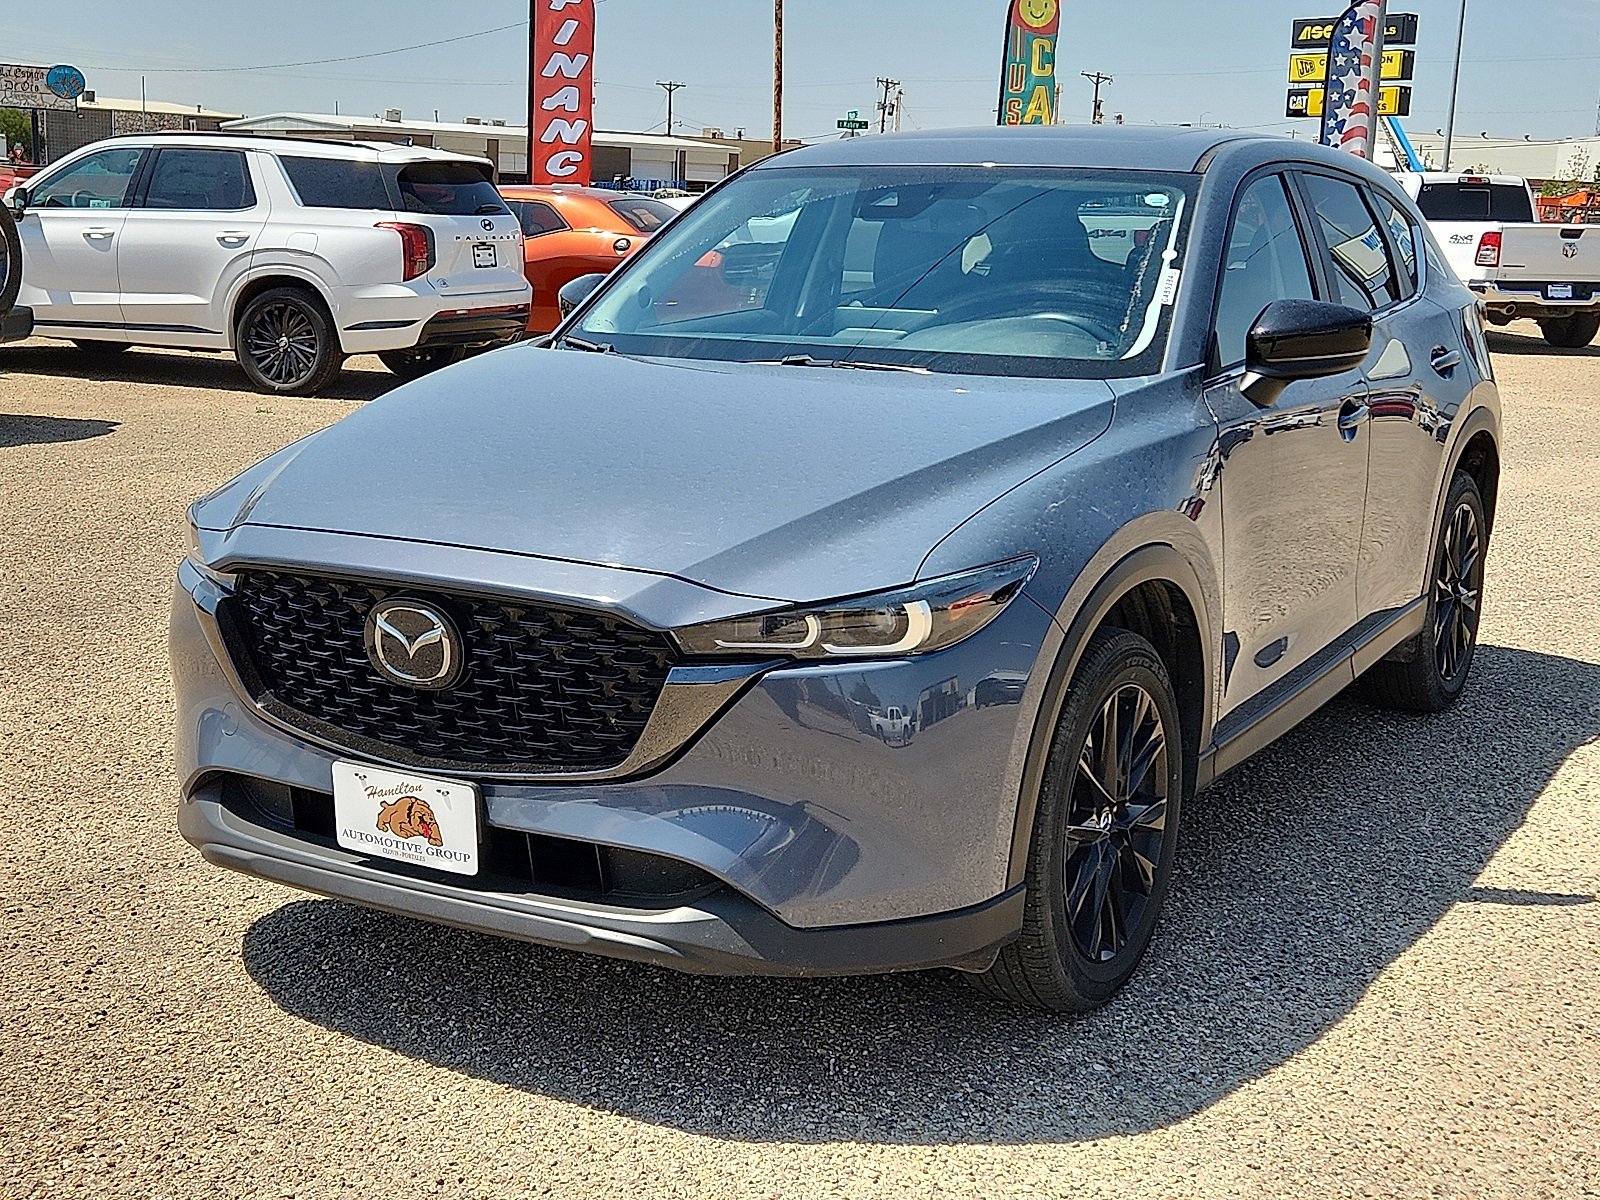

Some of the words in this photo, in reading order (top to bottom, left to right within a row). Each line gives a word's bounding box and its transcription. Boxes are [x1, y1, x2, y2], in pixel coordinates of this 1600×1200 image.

[1299, 60, 1315, 76] JCB
[539, 0, 591, 187] INANC
[1289, 95, 1308, 110] CAT
[364, 781, 424, 800] Hamilton
[341, 827, 423, 855] AUTOMOTIVE
[425, 846, 471, 863] GROUP
